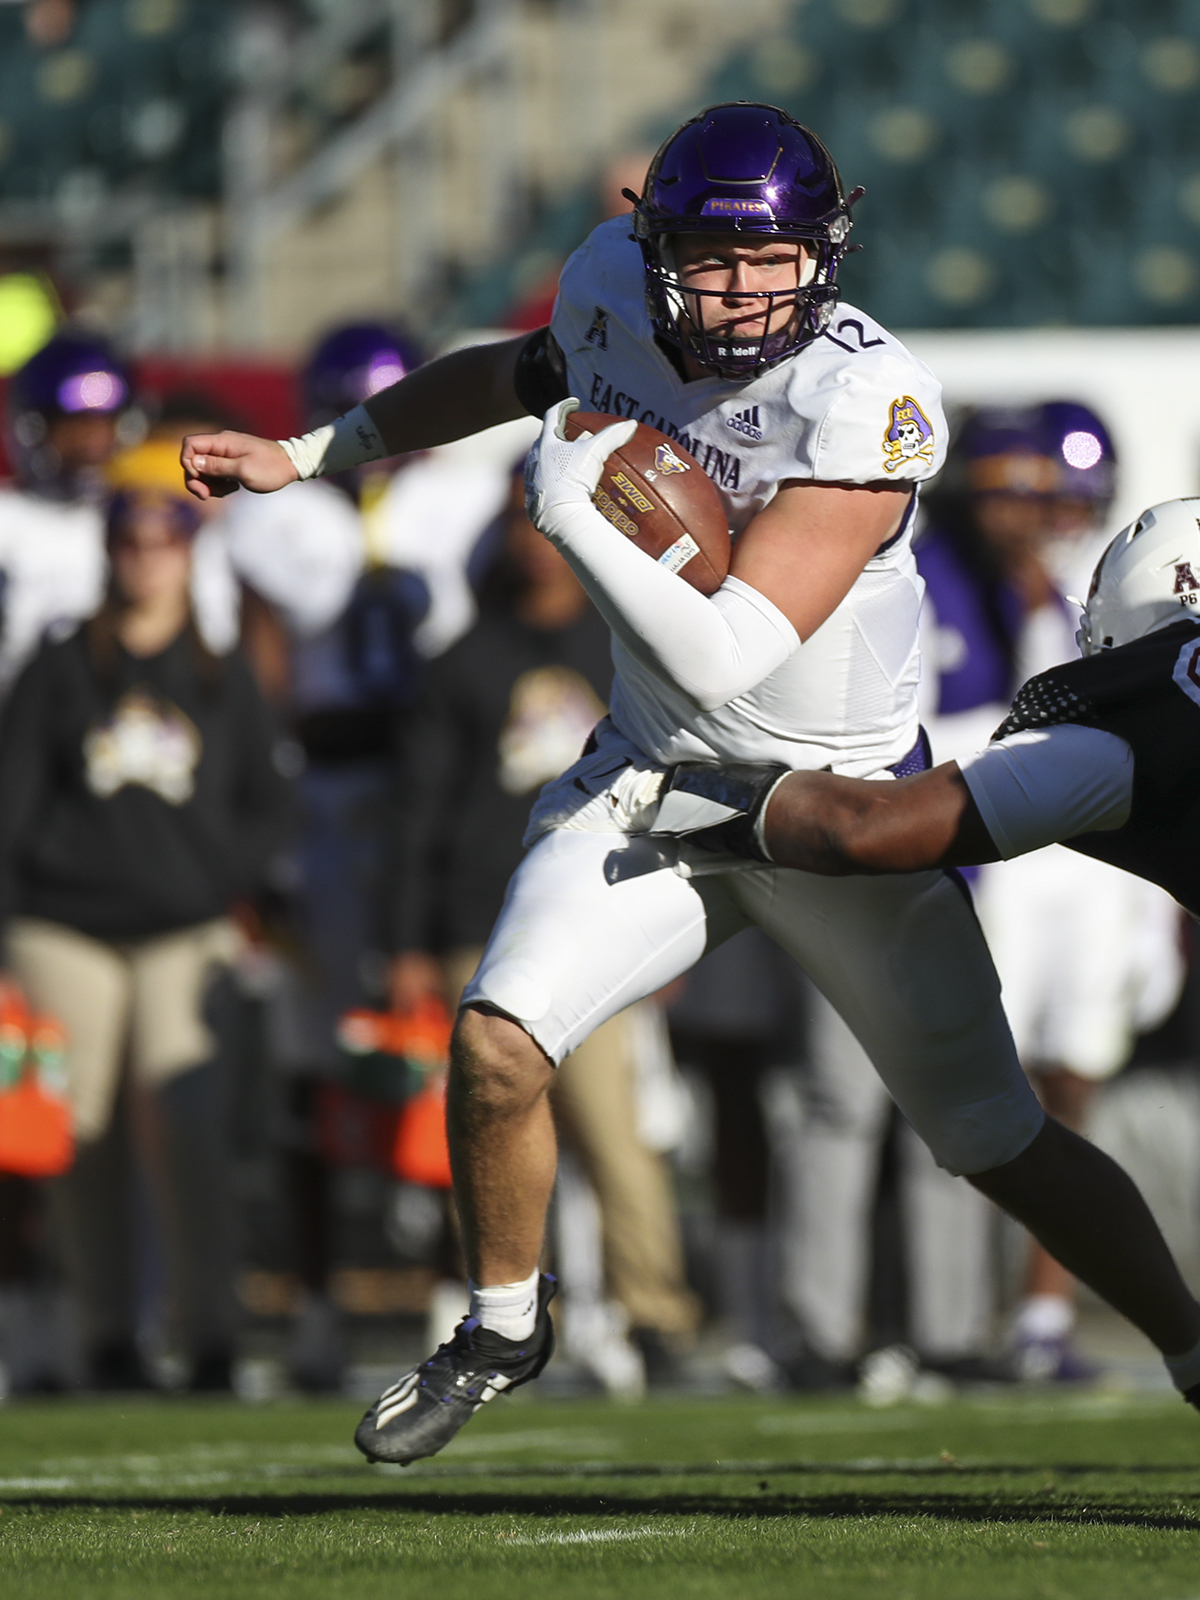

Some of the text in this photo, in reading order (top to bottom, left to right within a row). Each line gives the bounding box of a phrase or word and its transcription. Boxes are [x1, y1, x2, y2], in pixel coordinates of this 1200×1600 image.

[710, 200, 763, 212] PIRATES
[823, 318, 887, 354] 12
[718, 346, 756, 356] Rddell
[588, 371, 640, 419] EAST
[896, 406, 914, 422] ECU
[727, 417, 762, 441] adidas
[612, 473, 654, 512] DIME
[1180, 592, 1198, 606] P6
